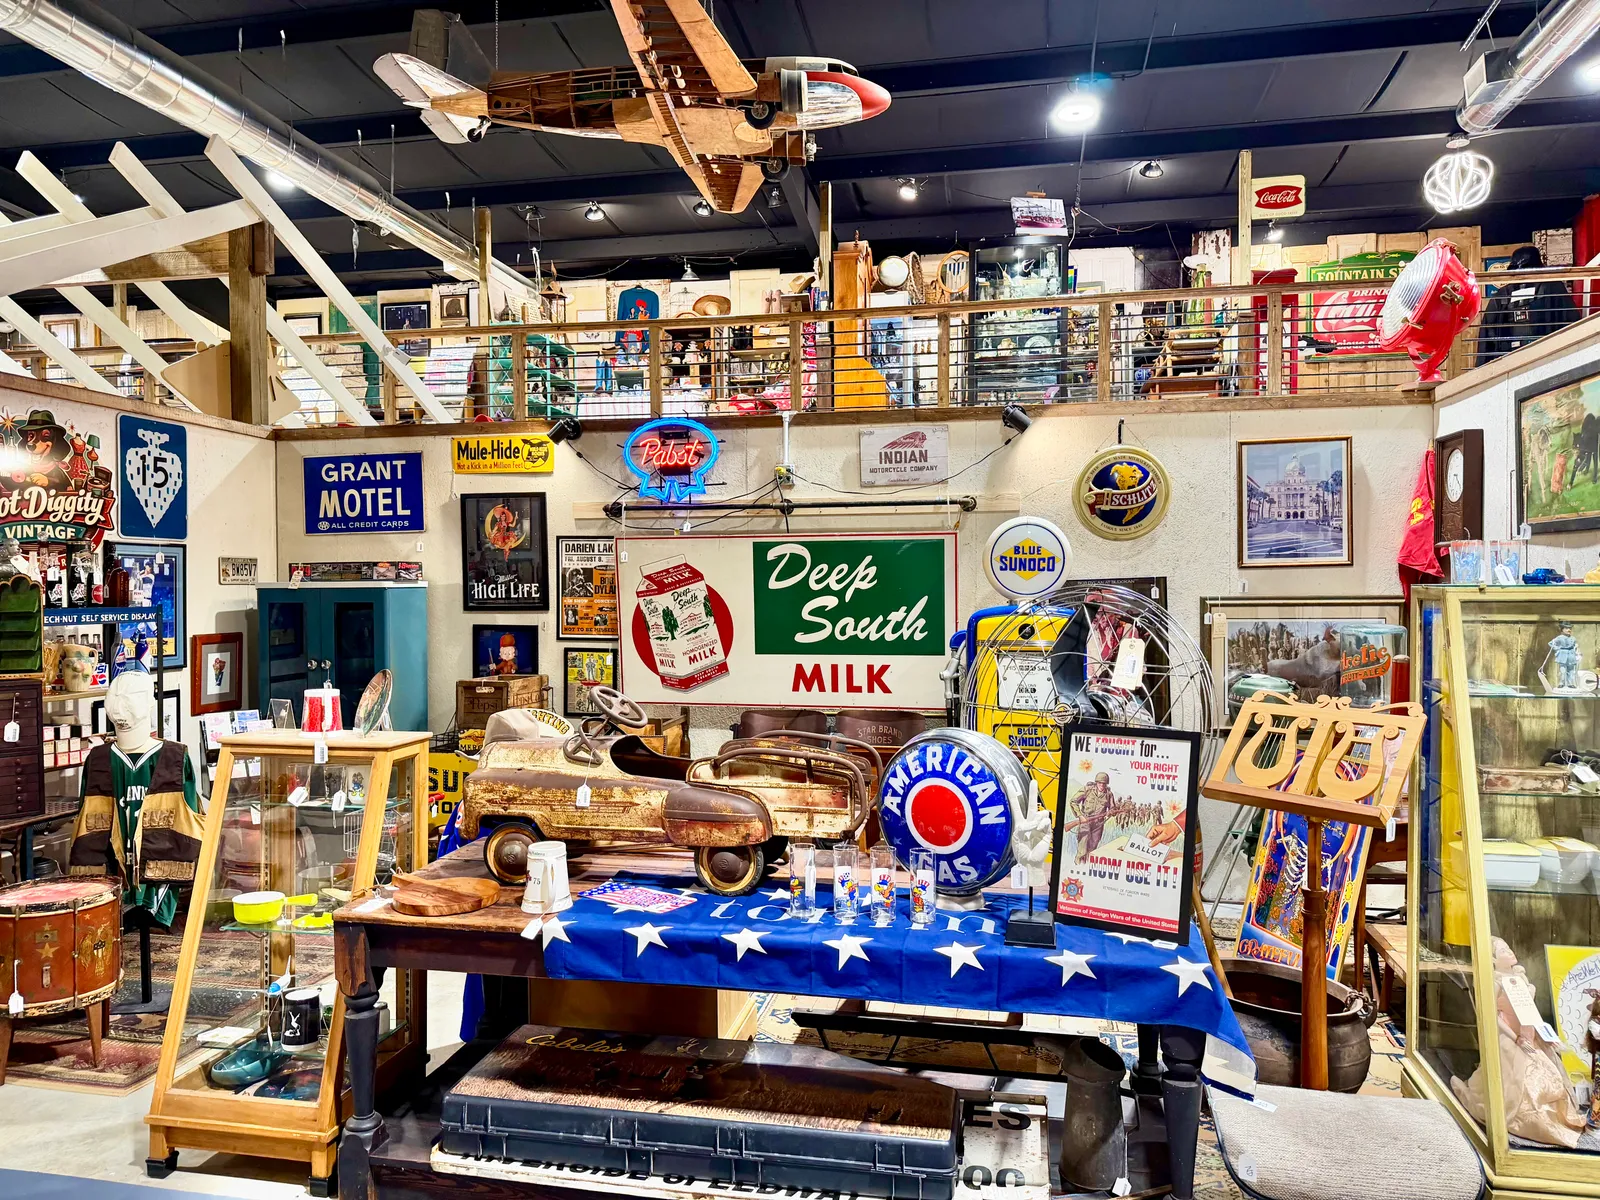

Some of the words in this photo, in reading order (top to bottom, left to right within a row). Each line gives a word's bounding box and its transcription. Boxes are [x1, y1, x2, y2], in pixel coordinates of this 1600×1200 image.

[457, 439, 520, 461] Mule-Hide
[639, 438, 704, 466] Pabst
[878, 449, 929, 465] INDIAN
[140, 454, 169, 489] 15
[321, 460, 406, 482] GRANT
[471, 462, 481, 470] Kick
[494, 461, 511, 469] Million
[319, 487, 411, 518] MOTEL
[1111, 480, 1157, 506] SCHLITZ
[21, 486, 106, 526] Diggity
[381, 520, 410, 528] CARDS
[565, 543, 595, 553] DARIEN
[1013, 545, 1042, 555] BLUE
[766, 543, 878, 603] Deep
[999, 556, 1056, 572] SUNOCO
[663, 571, 693, 584] MILK
[471, 579, 507, 599] HIGH
[510, 579, 540, 598] LIFE
[671, 587, 692, 603] Deep
[678, 593, 699, 610] South
[81, 614, 99, 622] SELF
[101, 613, 129, 622] SERVICE
[131, 612, 157, 620] DISPLAY
[794, 595, 928, 643] South
[682, 639, 718, 656] HOMOGENIZED
[688, 646, 717, 665] MILK
[658, 658, 676, 669] MILK
[791, 663, 893, 694] MILK
[858, 726, 877, 737] STAR
[878, 725, 903, 739] BRAND
[866, 736, 892, 744] SHOES
[1075, 736, 1091, 752] WE
[1094, 737, 1136, 756] FOUGHT
[1130, 761, 1151, 770] YOUR
[1153, 763, 1179, 773] RIGHT
[884, 747, 1006, 825] AMERICAN
[1137, 776, 1147, 784] TO
[1149, 773, 1178, 792] VOTE
[1130, 843, 1163, 857] BALLOT
[918, 853, 979, 884] GAS
[1125, 860, 1151, 885] USE
[533, 877, 541, 885] 75
[1060, 904, 1081, 913] Veterans
[1089, 910, 1109, 920] Foreign
[1142, 919, 1160, 927] United
[1161, 921, 1178, 929] States
[526, 1034, 626, 1053] Cabela's
